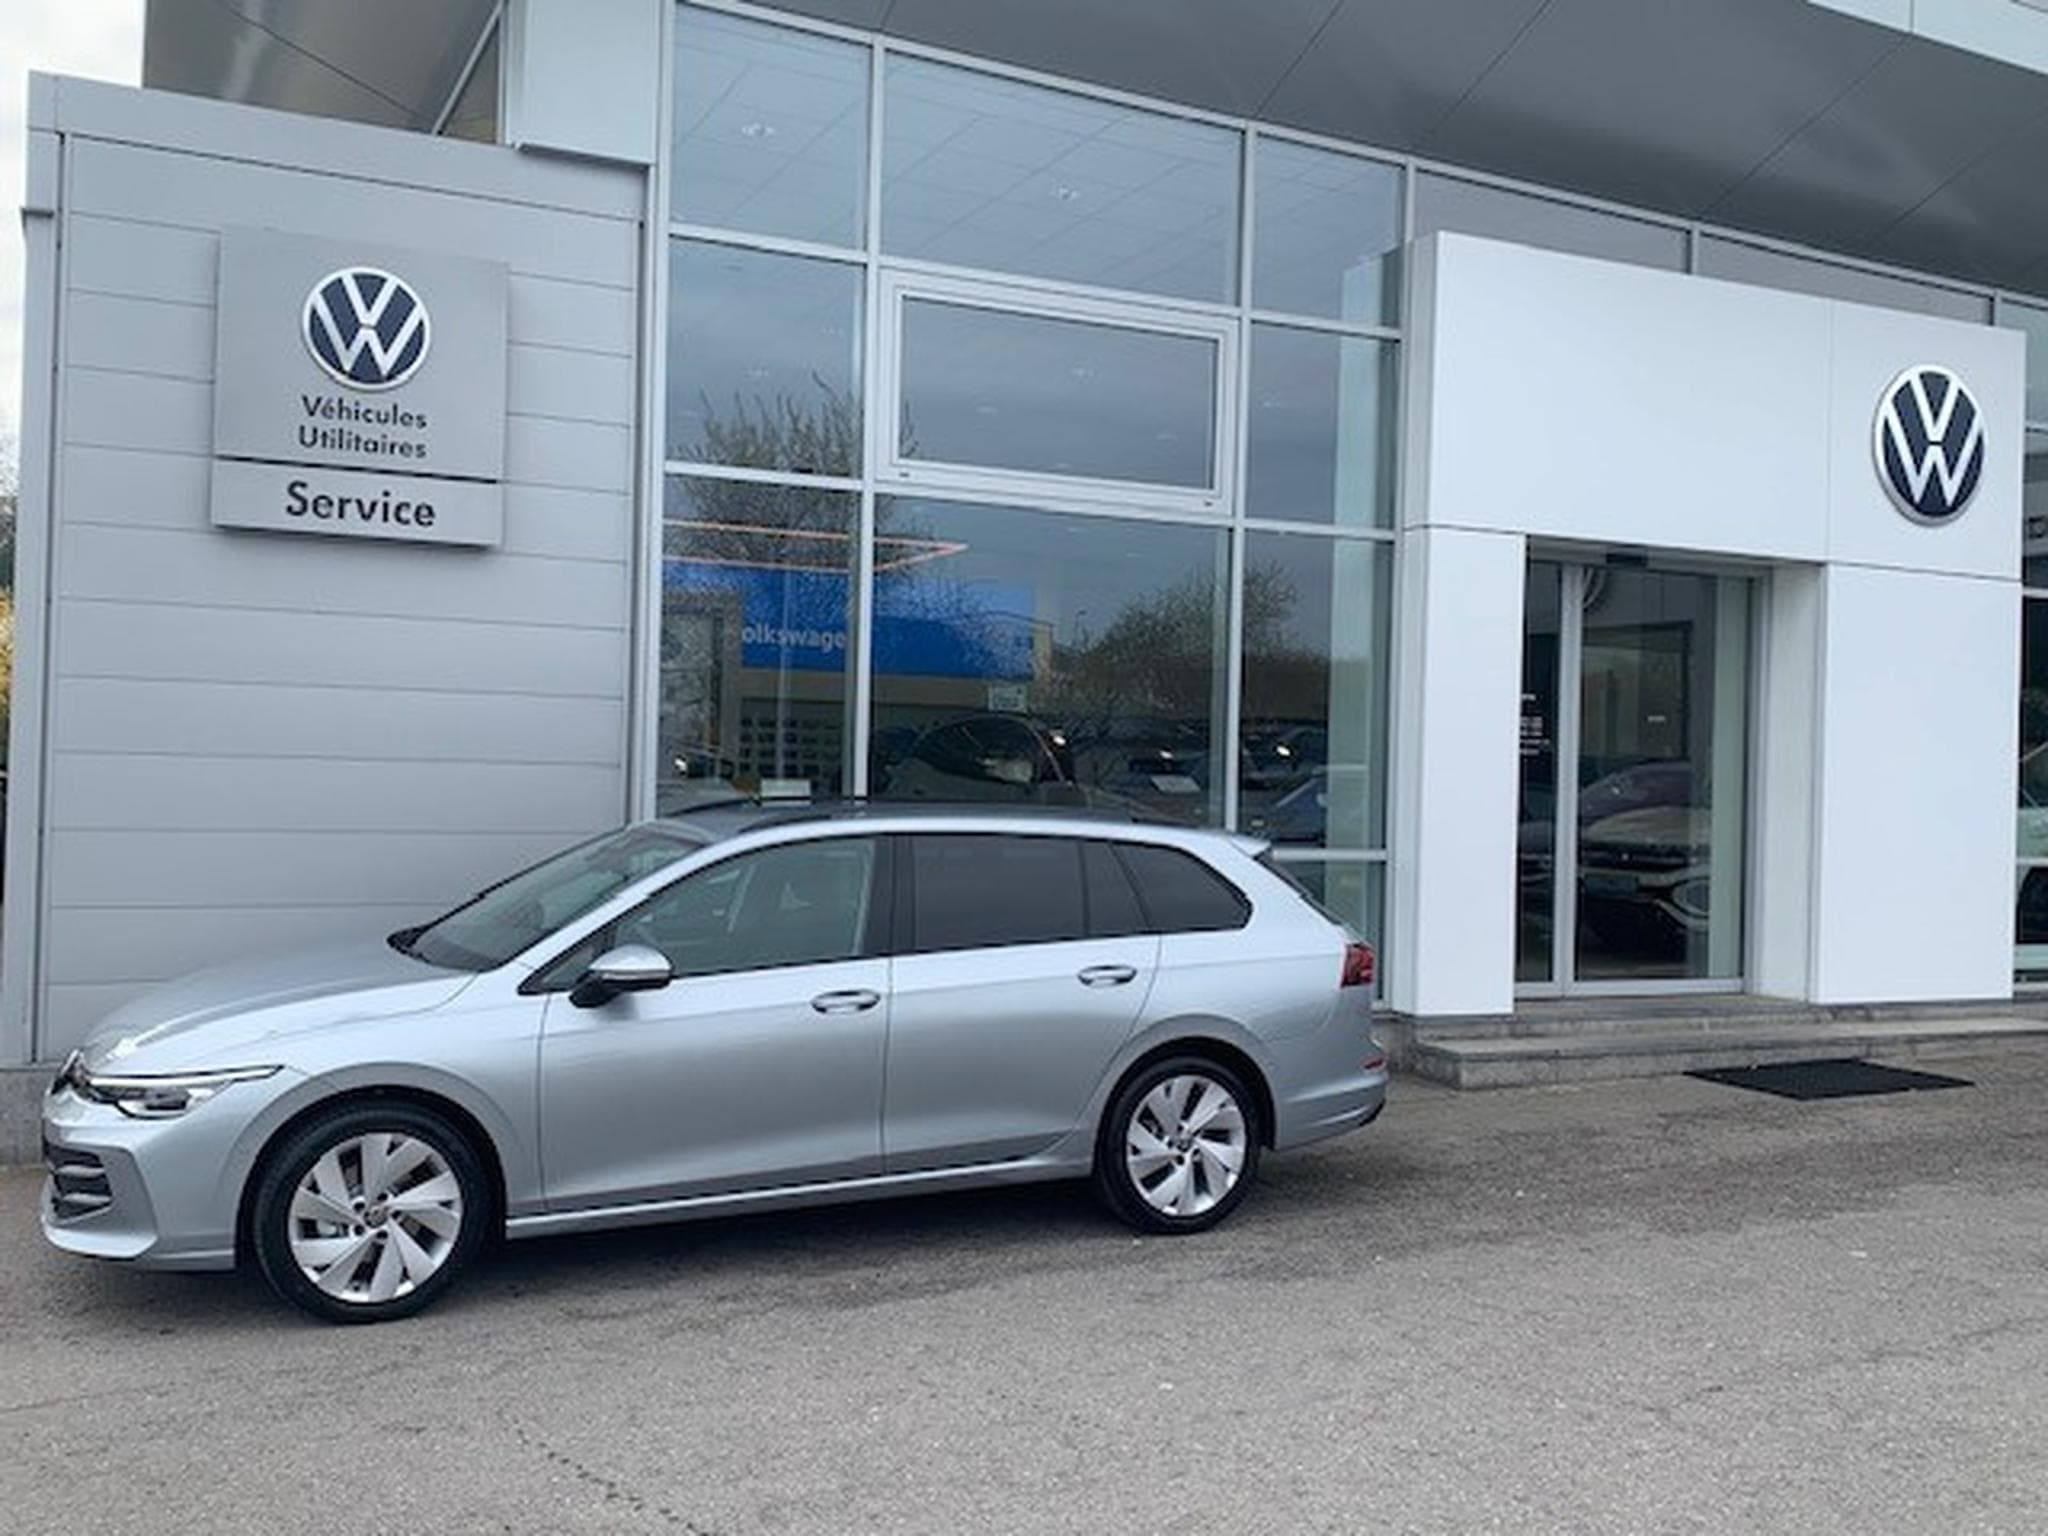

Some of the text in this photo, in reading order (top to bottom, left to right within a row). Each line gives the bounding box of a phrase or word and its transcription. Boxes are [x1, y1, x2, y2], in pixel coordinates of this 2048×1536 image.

[303, 267, 430, 390] VW
[302, 395, 427, 428] Véhicules
[299, 425, 427, 458] Utilitaires
[1874, 364, 1988, 525] VW
[286, 481, 435, 526] Service
[741, 623, 846, 653] olkswage
